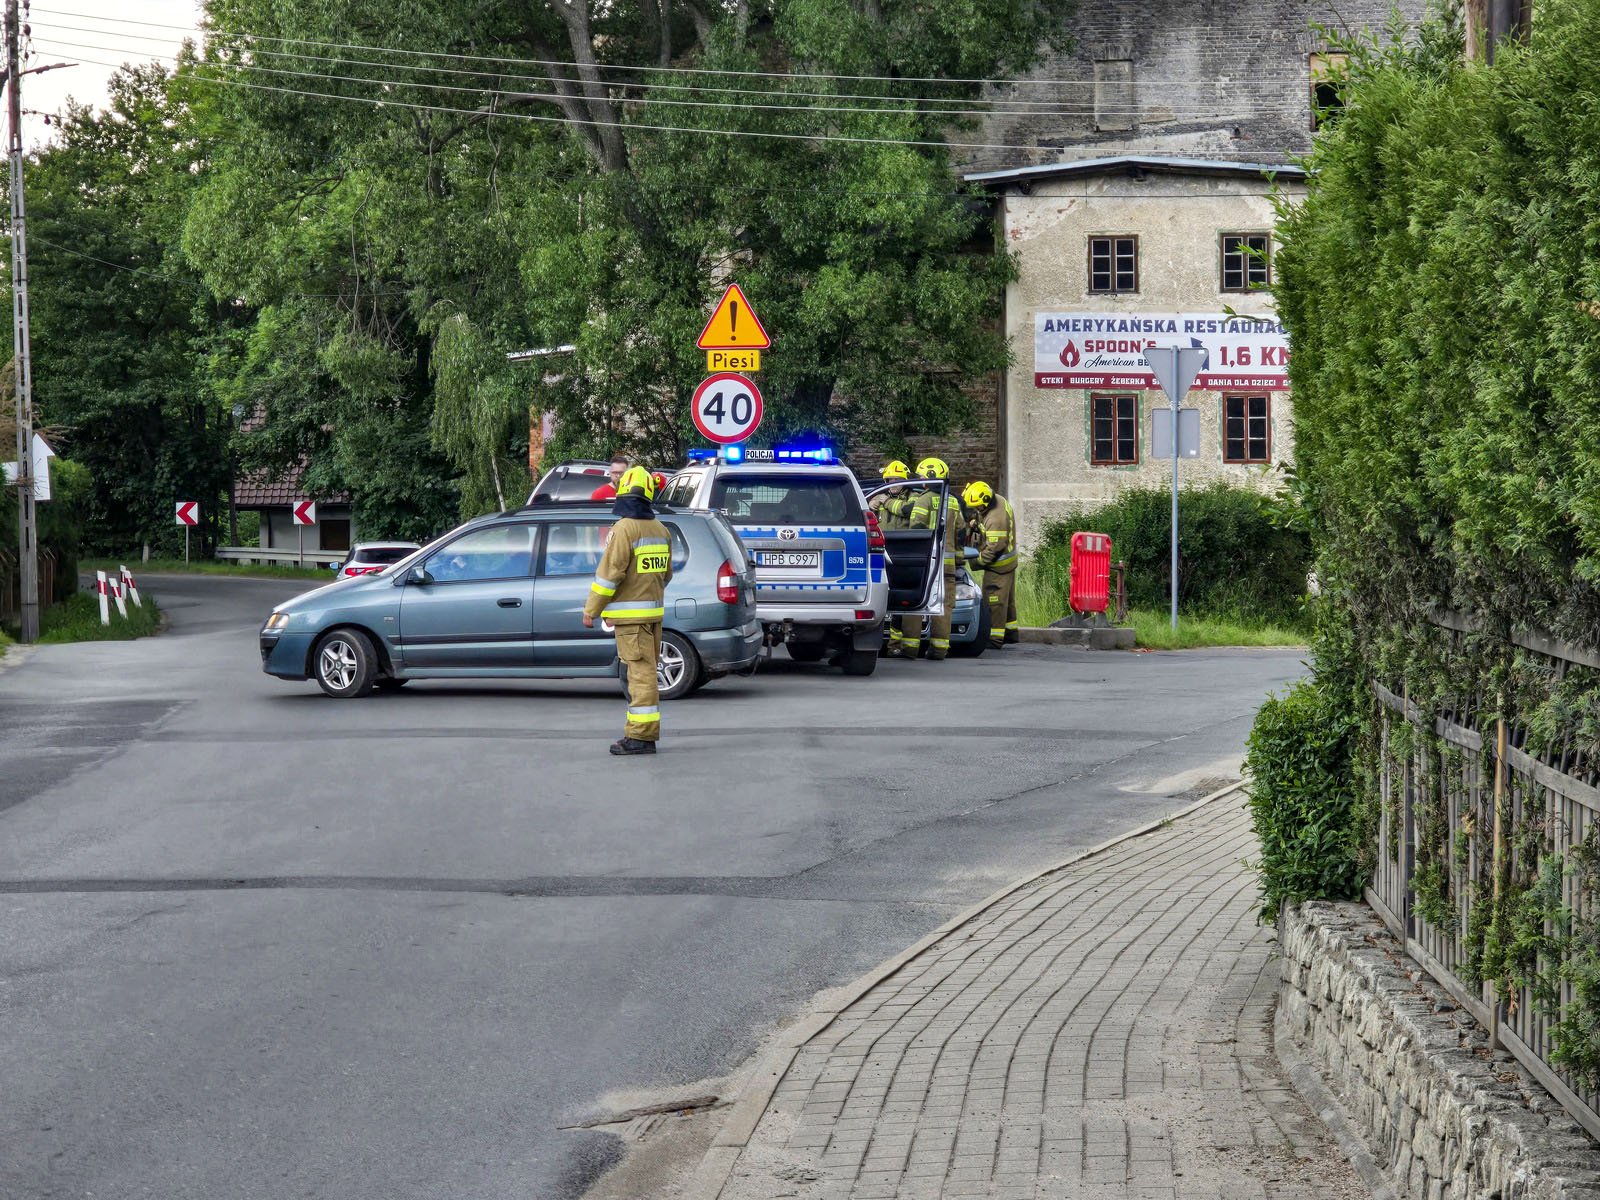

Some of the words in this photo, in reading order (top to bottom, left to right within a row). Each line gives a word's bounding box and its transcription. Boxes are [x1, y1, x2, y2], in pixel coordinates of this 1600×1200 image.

[1044, 316, 1177, 333] AMERYKAŃSKA
[713, 352, 754, 368] Piesi
[1084, 354, 1135, 368] American
[1220, 346, 1251, 368] 1,6
[1070, 377, 1105, 385] BURGERY
[1111, 376, 1146, 385] ŻEBERKA
[1208, 378, 1232, 386] DANIA
[1234, 378, 1249, 386] DLA
[1251, 378, 1276, 386] DZIECI
[703, 392, 753, 426] 40
[746, 450, 773, 459] POLICJA
[764, 554, 785, 565] HPB
[788, 554, 815, 565] C997
[848, 556, 864, 565] B578
